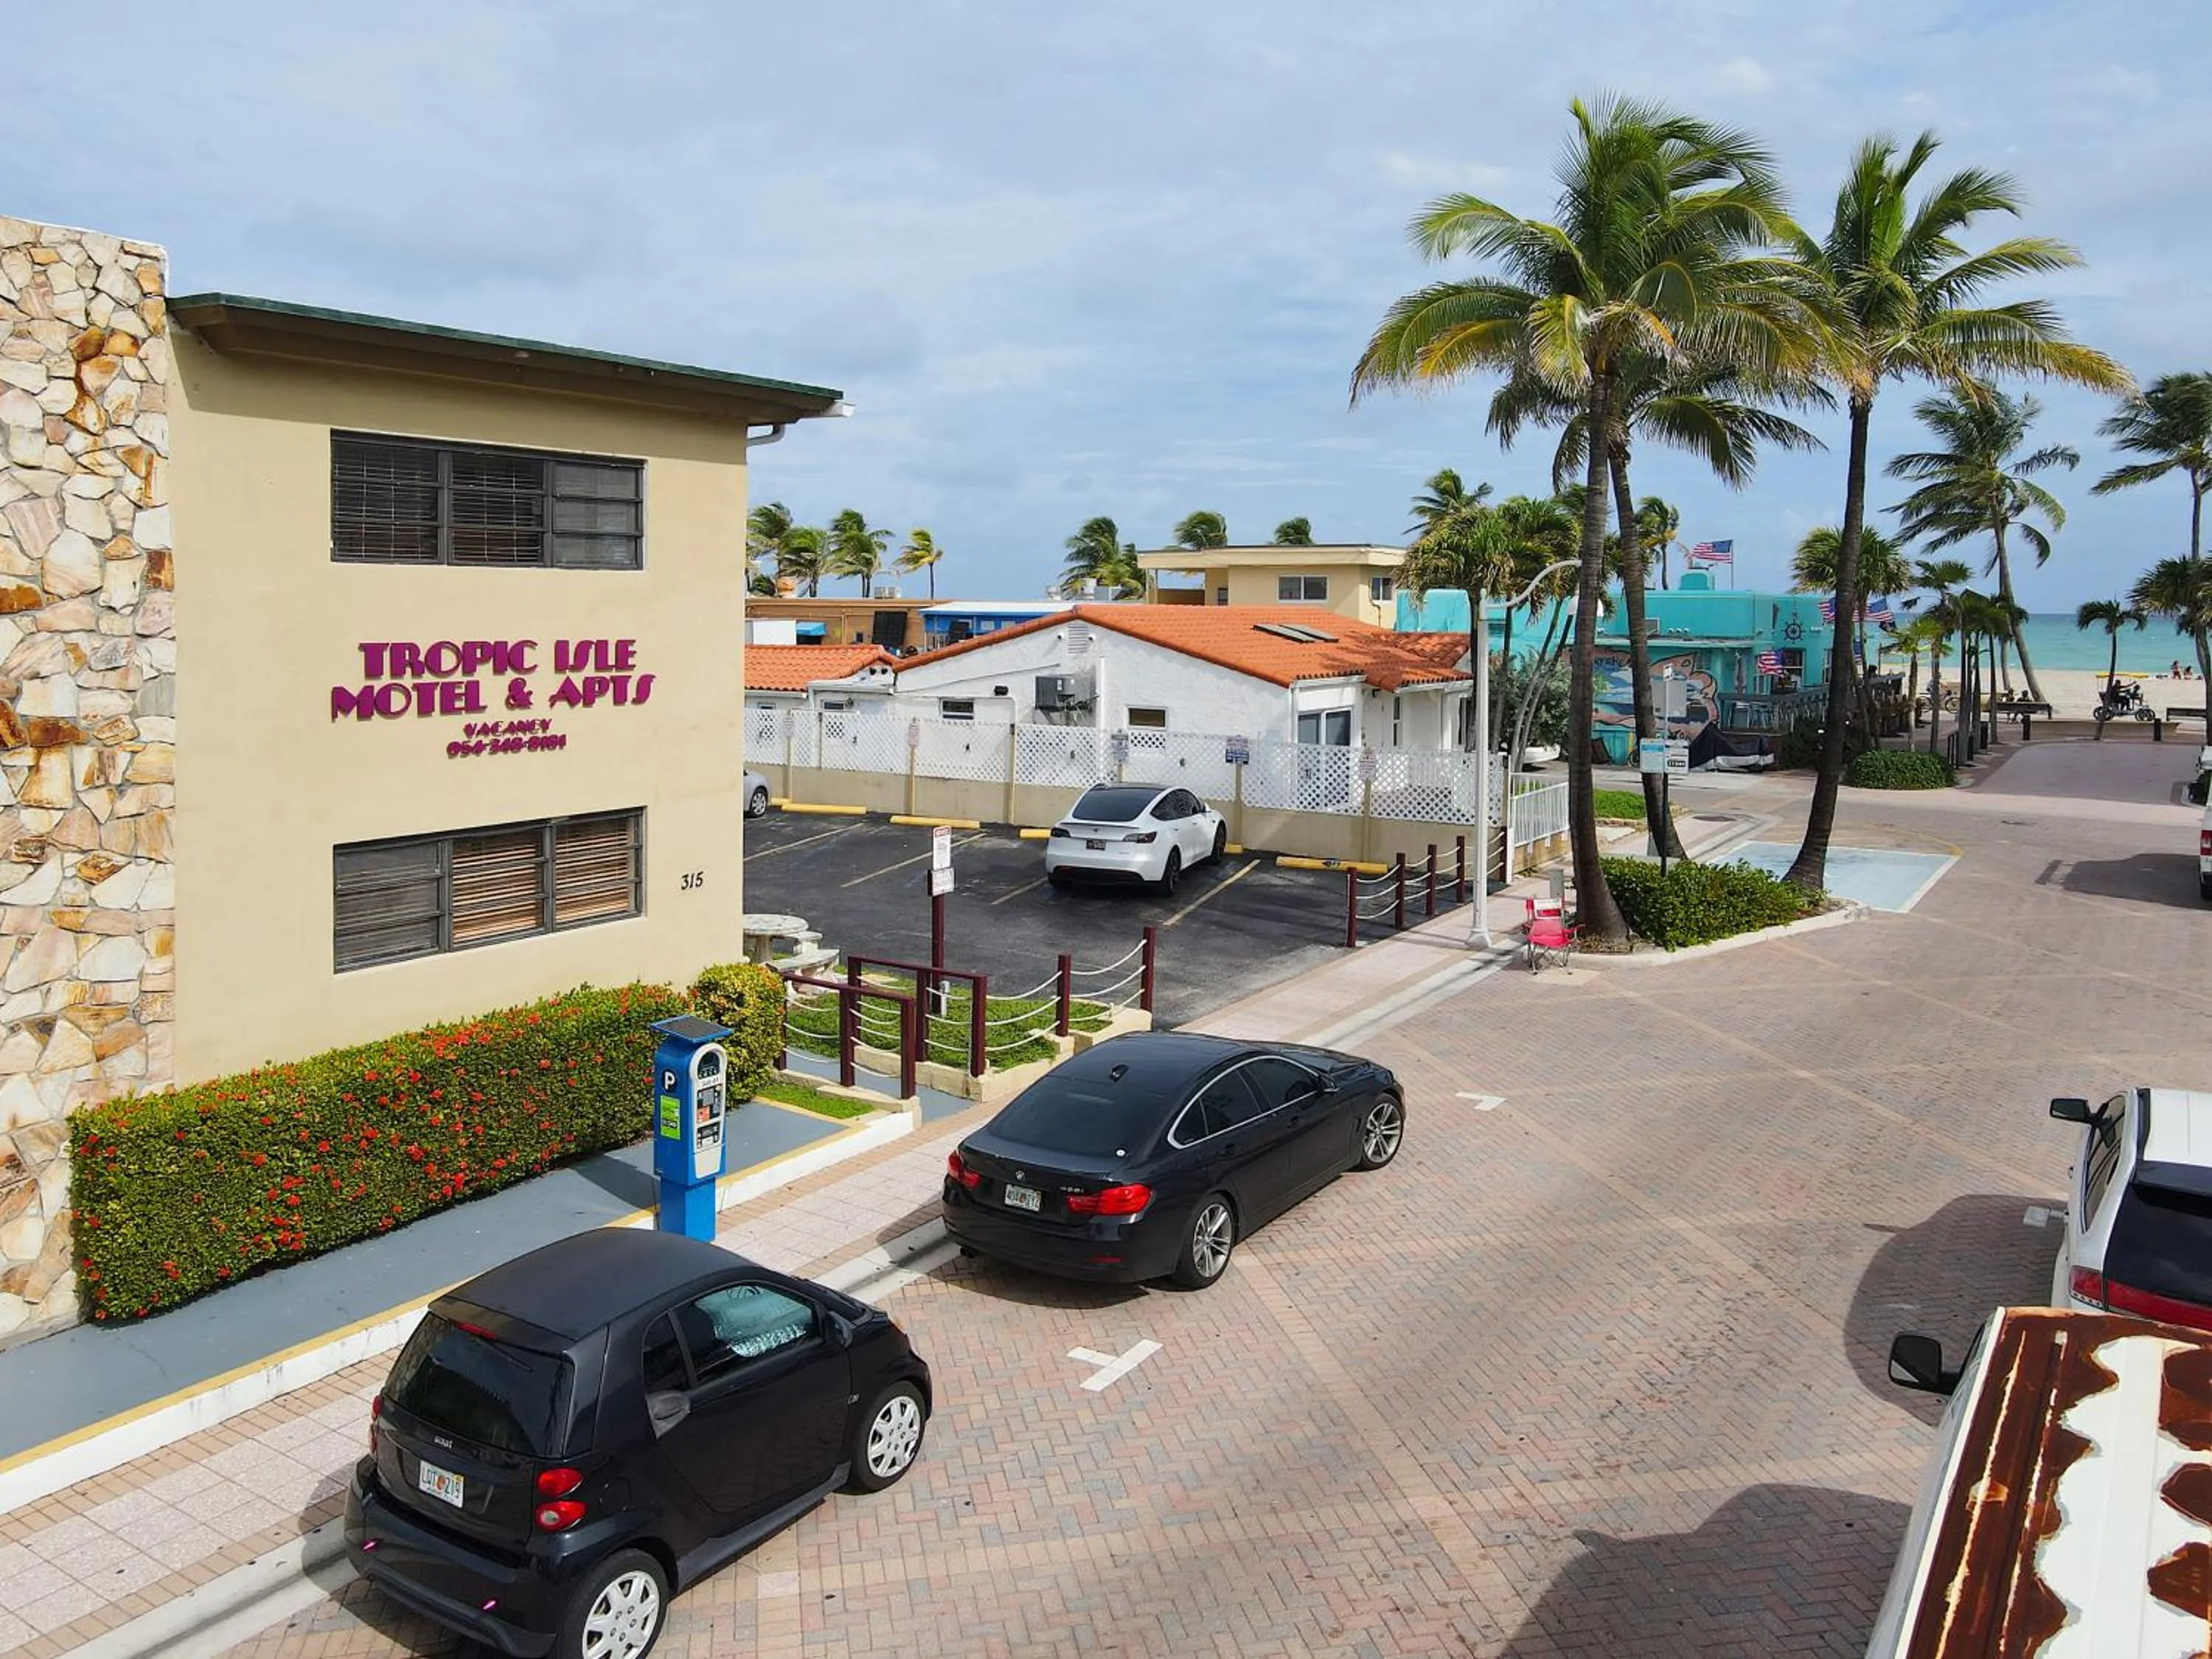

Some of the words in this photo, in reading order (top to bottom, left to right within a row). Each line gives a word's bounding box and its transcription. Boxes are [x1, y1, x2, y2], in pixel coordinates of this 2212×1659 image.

[358, 640, 538, 679] TROPIC
[554, 639, 637, 673] ISLE
[331, 680, 487, 722] MOTEL
[505, 677, 533, 710] &
[549, 673, 656, 709] APTS
[463, 718, 552, 738] VACANCY
[681, 870, 704, 891] 315
[664, 1071, 675, 1090] P
